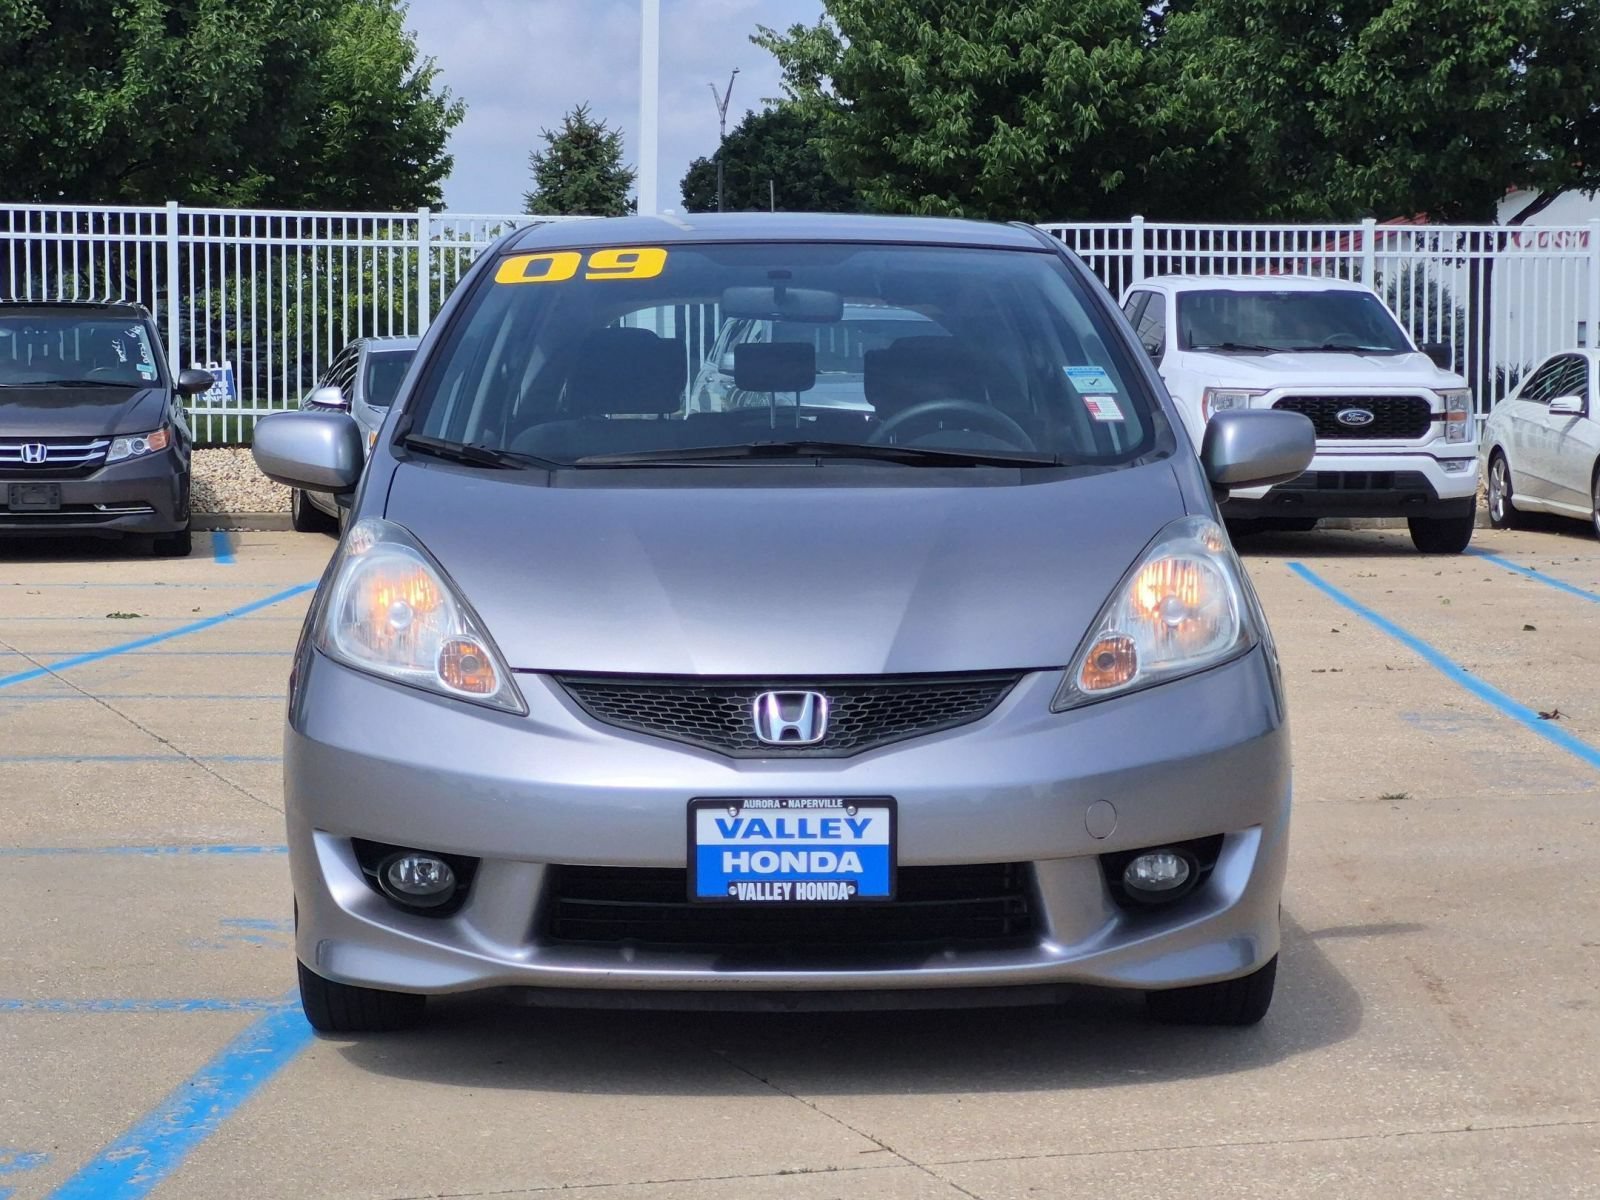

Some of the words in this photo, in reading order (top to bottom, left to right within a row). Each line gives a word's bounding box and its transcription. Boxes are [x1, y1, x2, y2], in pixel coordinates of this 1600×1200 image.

[494, 248, 668, 284] 09
[743, 799, 780, 809] AURORA
[788, 799, 843, 808] NAPERVILLE
[714, 818, 872, 839] VALLEY
[722, 851, 864, 873] HONDA
[737, 882, 792, 901] VALLEY
[797, 882, 849, 900] HONDA
